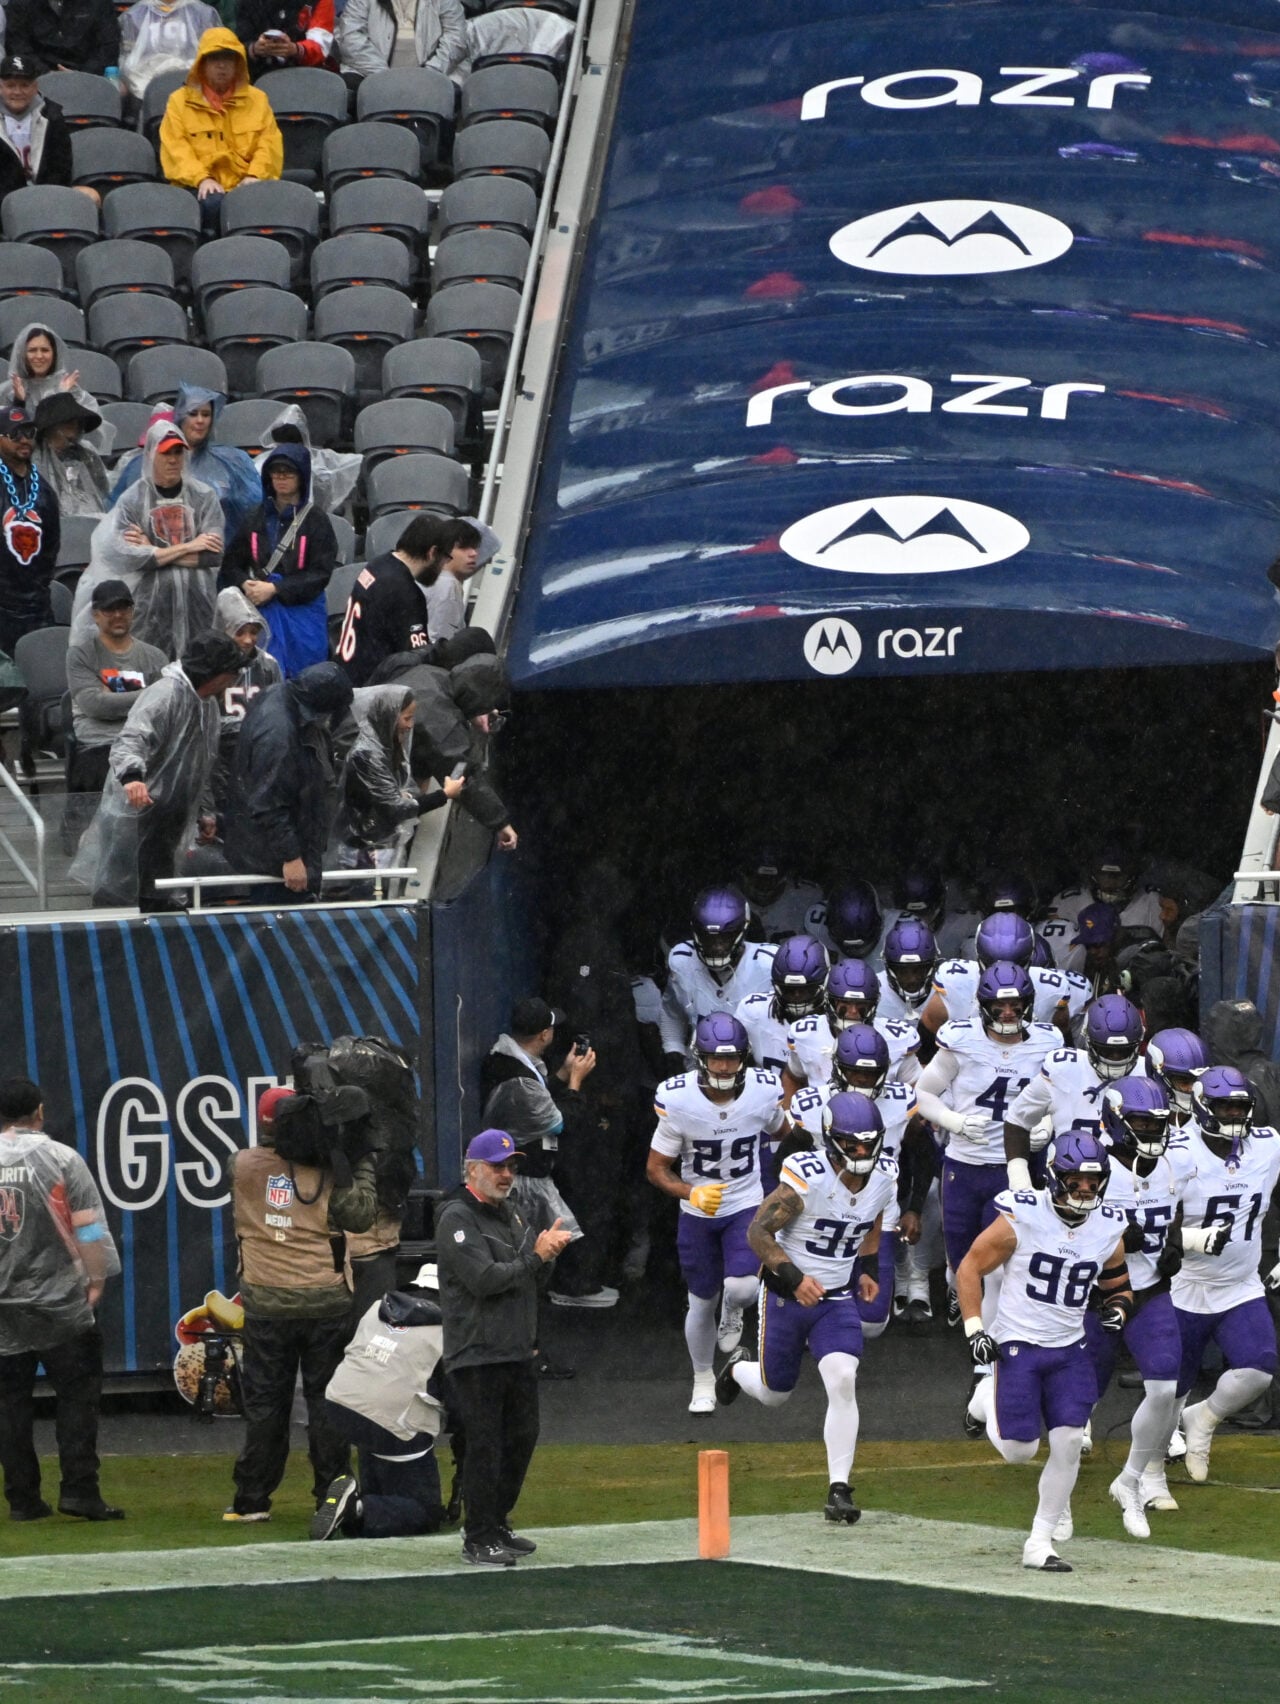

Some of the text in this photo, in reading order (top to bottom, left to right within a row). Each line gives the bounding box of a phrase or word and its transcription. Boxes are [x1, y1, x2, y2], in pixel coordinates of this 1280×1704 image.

[800, 67, 1151, 120] razr
[746, 374, 1105, 427] razr
[877, 626, 963, 659] razr
[224, 686, 261, 721] 5
[692, 1135, 757, 1180] 29
[269, 1187, 290, 1205] NFL
[1026, 1252, 1099, 1308] 98
